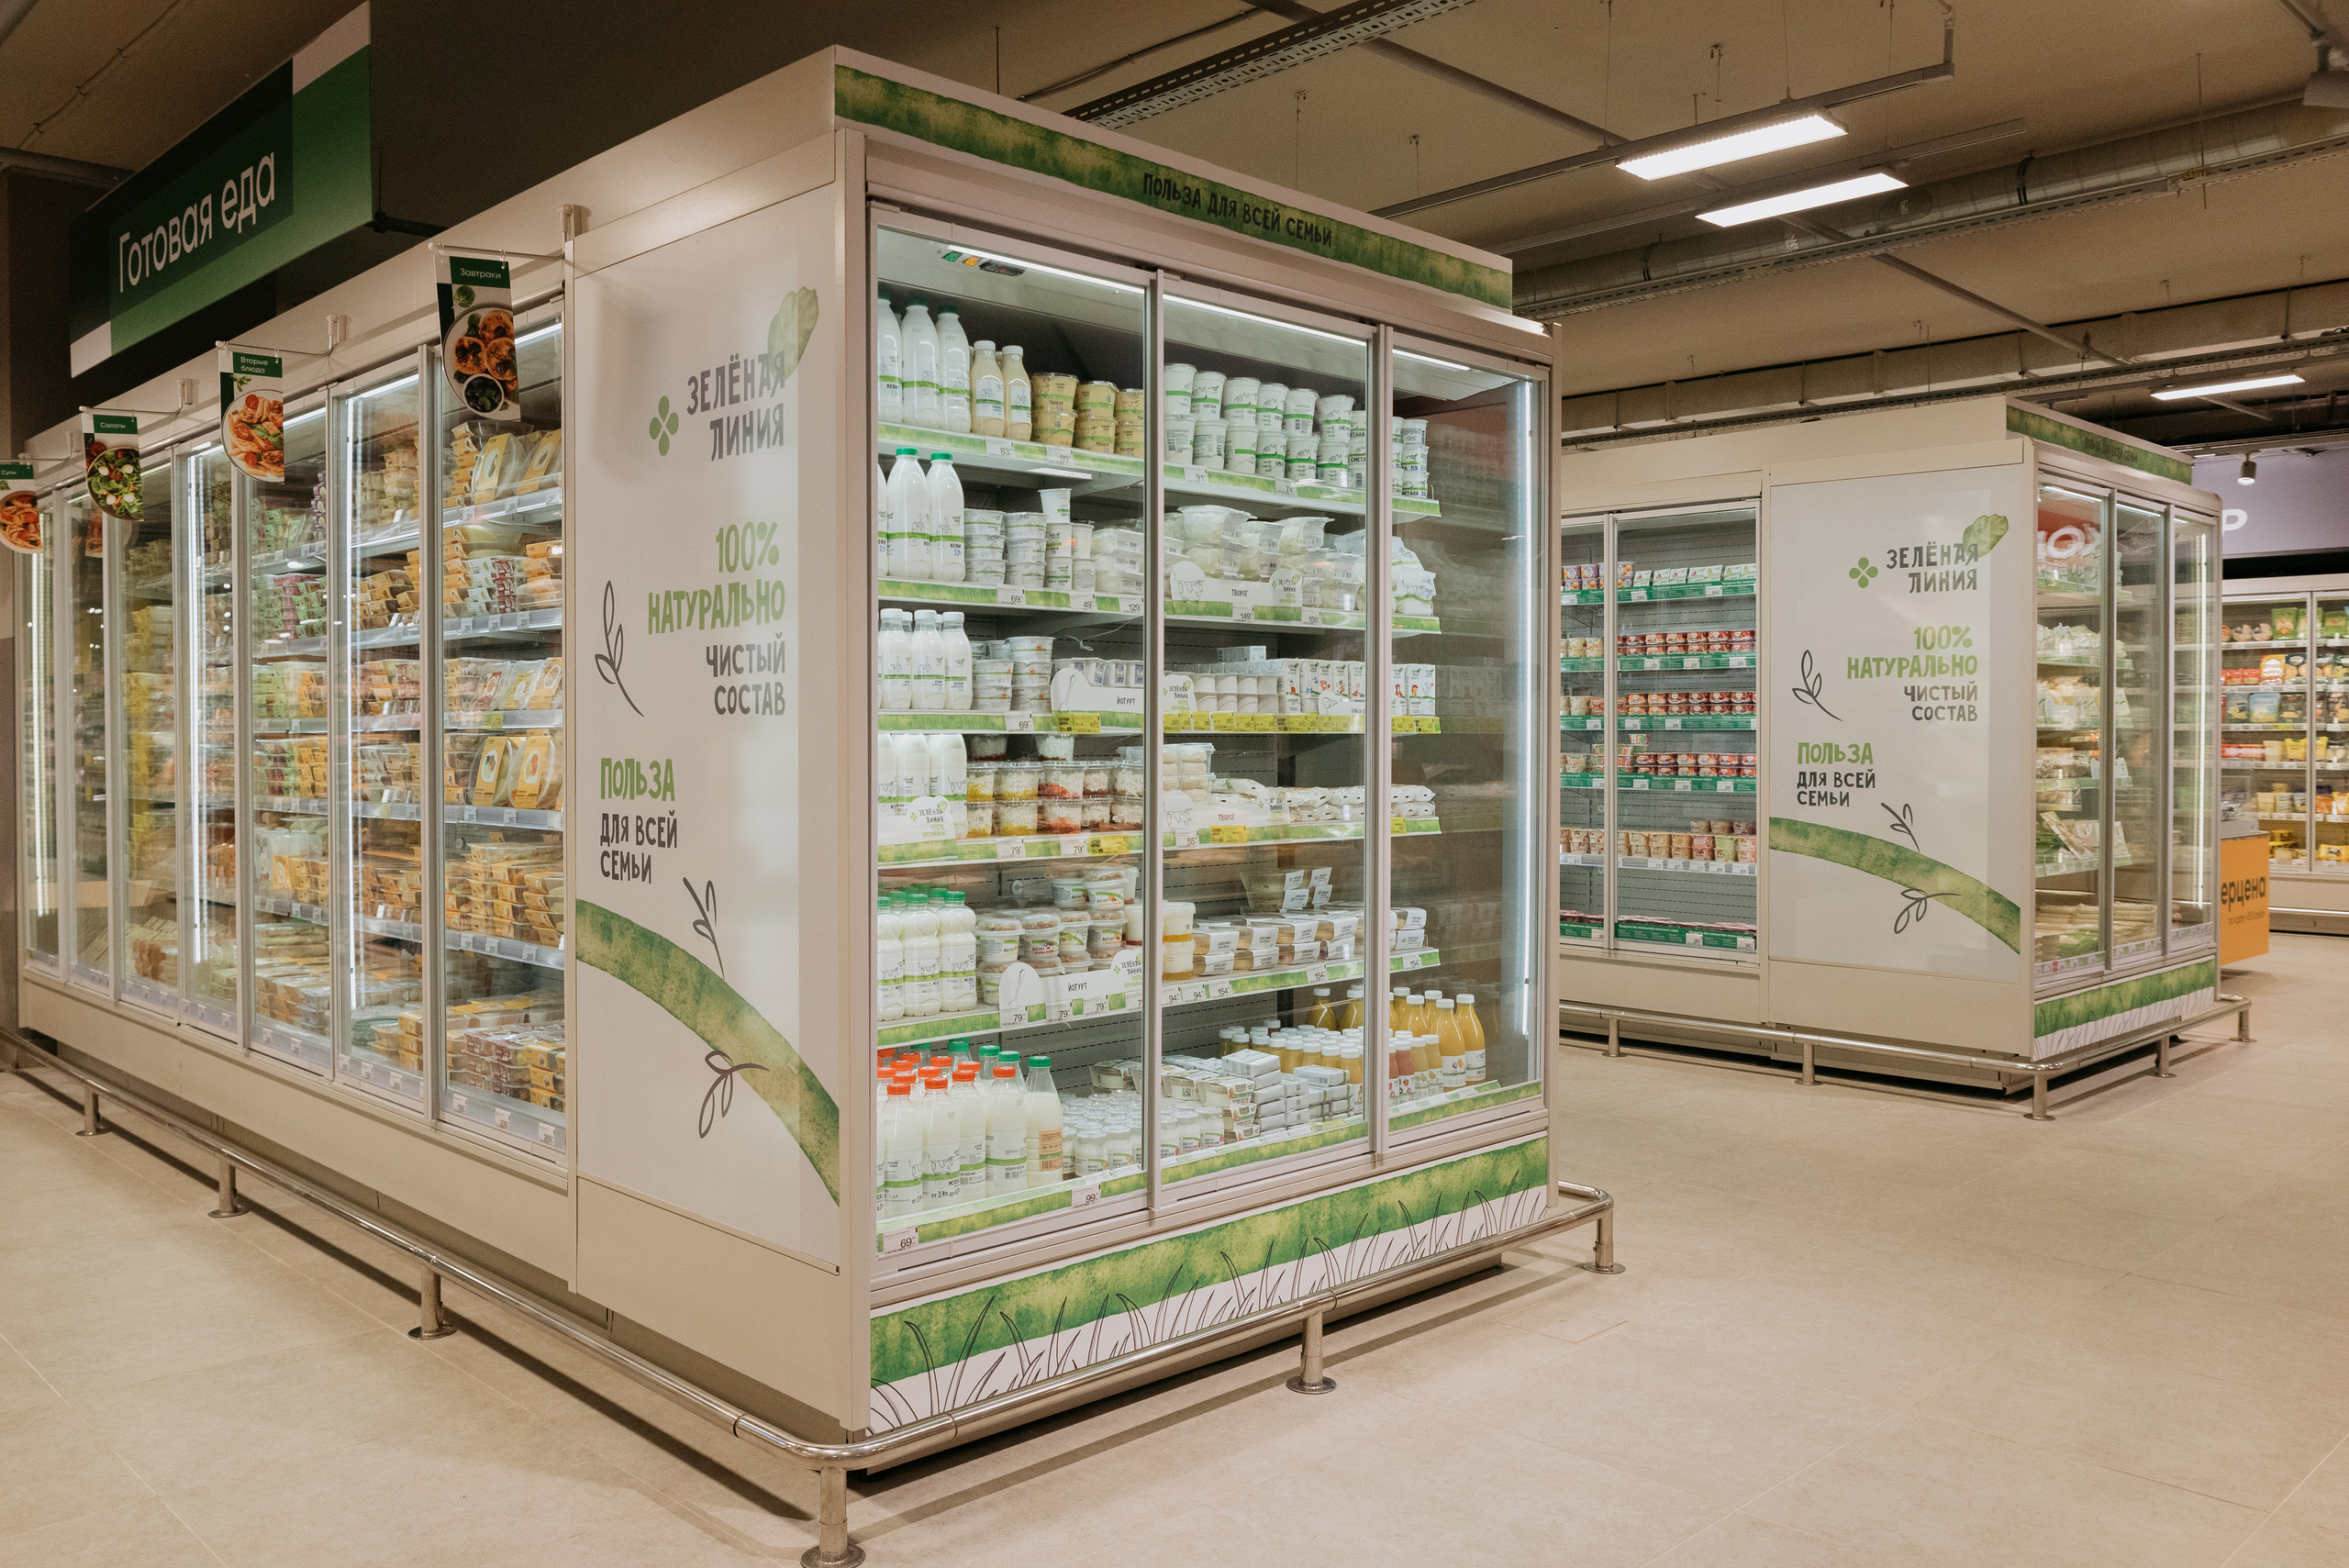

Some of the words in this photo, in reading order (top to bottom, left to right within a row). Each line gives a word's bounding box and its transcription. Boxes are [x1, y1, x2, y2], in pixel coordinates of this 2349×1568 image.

[1143, 172, 1202, 211] ПОЛЬЗА
[1208, 193, 1238, 219] ДЛЯ
[1242, 203, 1281, 233] ВСЕЙ
[1286, 217, 1332, 249] СЕМЬИ
[119, 194, 212, 293] Готовая
[221, 152, 274, 234] еда
[460, 268, 501, 279] Завтраки
[240, 356, 268, 366] Вторые
[240, 365, 265, 373] блюда
[686, 350, 785, 416] ЗЕЛЁНАЯ
[709, 402, 785, 462] ЛИНИЯ
[716, 520, 780, 573] 100%
[1886, 540, 1978, 570] ЗЕЛЁНАЯ
[1909, 568, 1977, 594] ЛИНИЯ
[1231, 589, 1248, 597] ТВОРОГ
[648, 578, 785, 637] НАТУРАЛЬНО
[1913, 625, 1973, 651] 100%
[706, 632, 785, 678] ЧИСТЫЙ
[1847, 654, 1978, 679] НАТУРАЛЬНО
[713, 681, 785, 717] СОСТАВ
[1117, 695, 1135, 705] ЙОГУРТ
[1904, 681, 1977, 702] ЧИСТЫЙ
[1911, 705, 1977, 721] СОСТАВ
[1798, 742, 1874, 764] ПОЛЬЗА
[599, 757, 675, 802] ПОЛЬЗА
[1797, 772, 1827, 789] ДЛЯ
[1833, 769, 1876, 788] ВСЕЙ
[1797, 791, 1850, 807] СЕМЬИ
[1218, 814, 1235, 822] ТВОРОГ
[599, 813, 629, 847] ДЛЯ
[635, 810, 678, 849] ВСЕЙ
[1010, 846, 1020, 855] 79
[1074, 846, 1083, 854] 79
[599, 851, 651, 884] СЕМЬИ
[1067, 982, 1087, 992] ЙОГУРТ
[1059, 1010, 1068, 1018] 79
[1096, 1003, 1105, 1011] 79
[1013, 1014, 1023, 1022] 79
[1085, 1194, 1097, 1204] 99
[900, 1238, 912, 1249] 69
